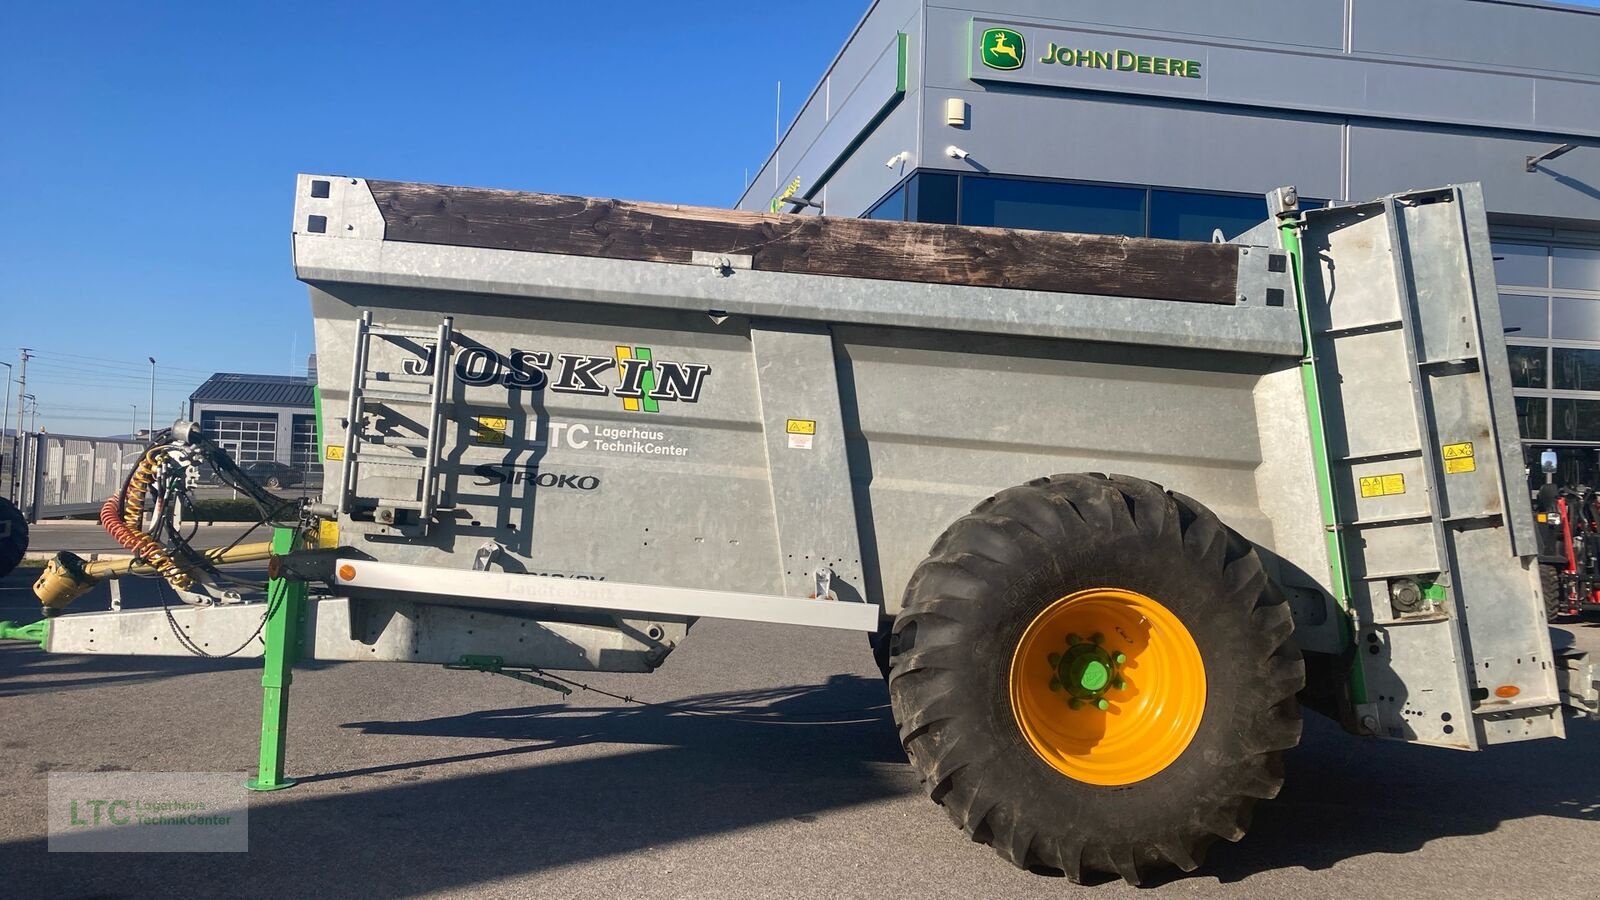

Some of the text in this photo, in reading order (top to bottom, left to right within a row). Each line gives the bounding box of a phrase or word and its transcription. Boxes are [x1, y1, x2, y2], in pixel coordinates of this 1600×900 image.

[1039, 42, 1202, 79] JOHN DEERE
[401, 343, 711, 402] JOSKIN
[529, 420, 590, 449] LTC
[594, 425, 664, 441] Lagerhaus
[594, 440, 688, 456] TechnikCenter
[473, 463, 600, 490] SIROKO
